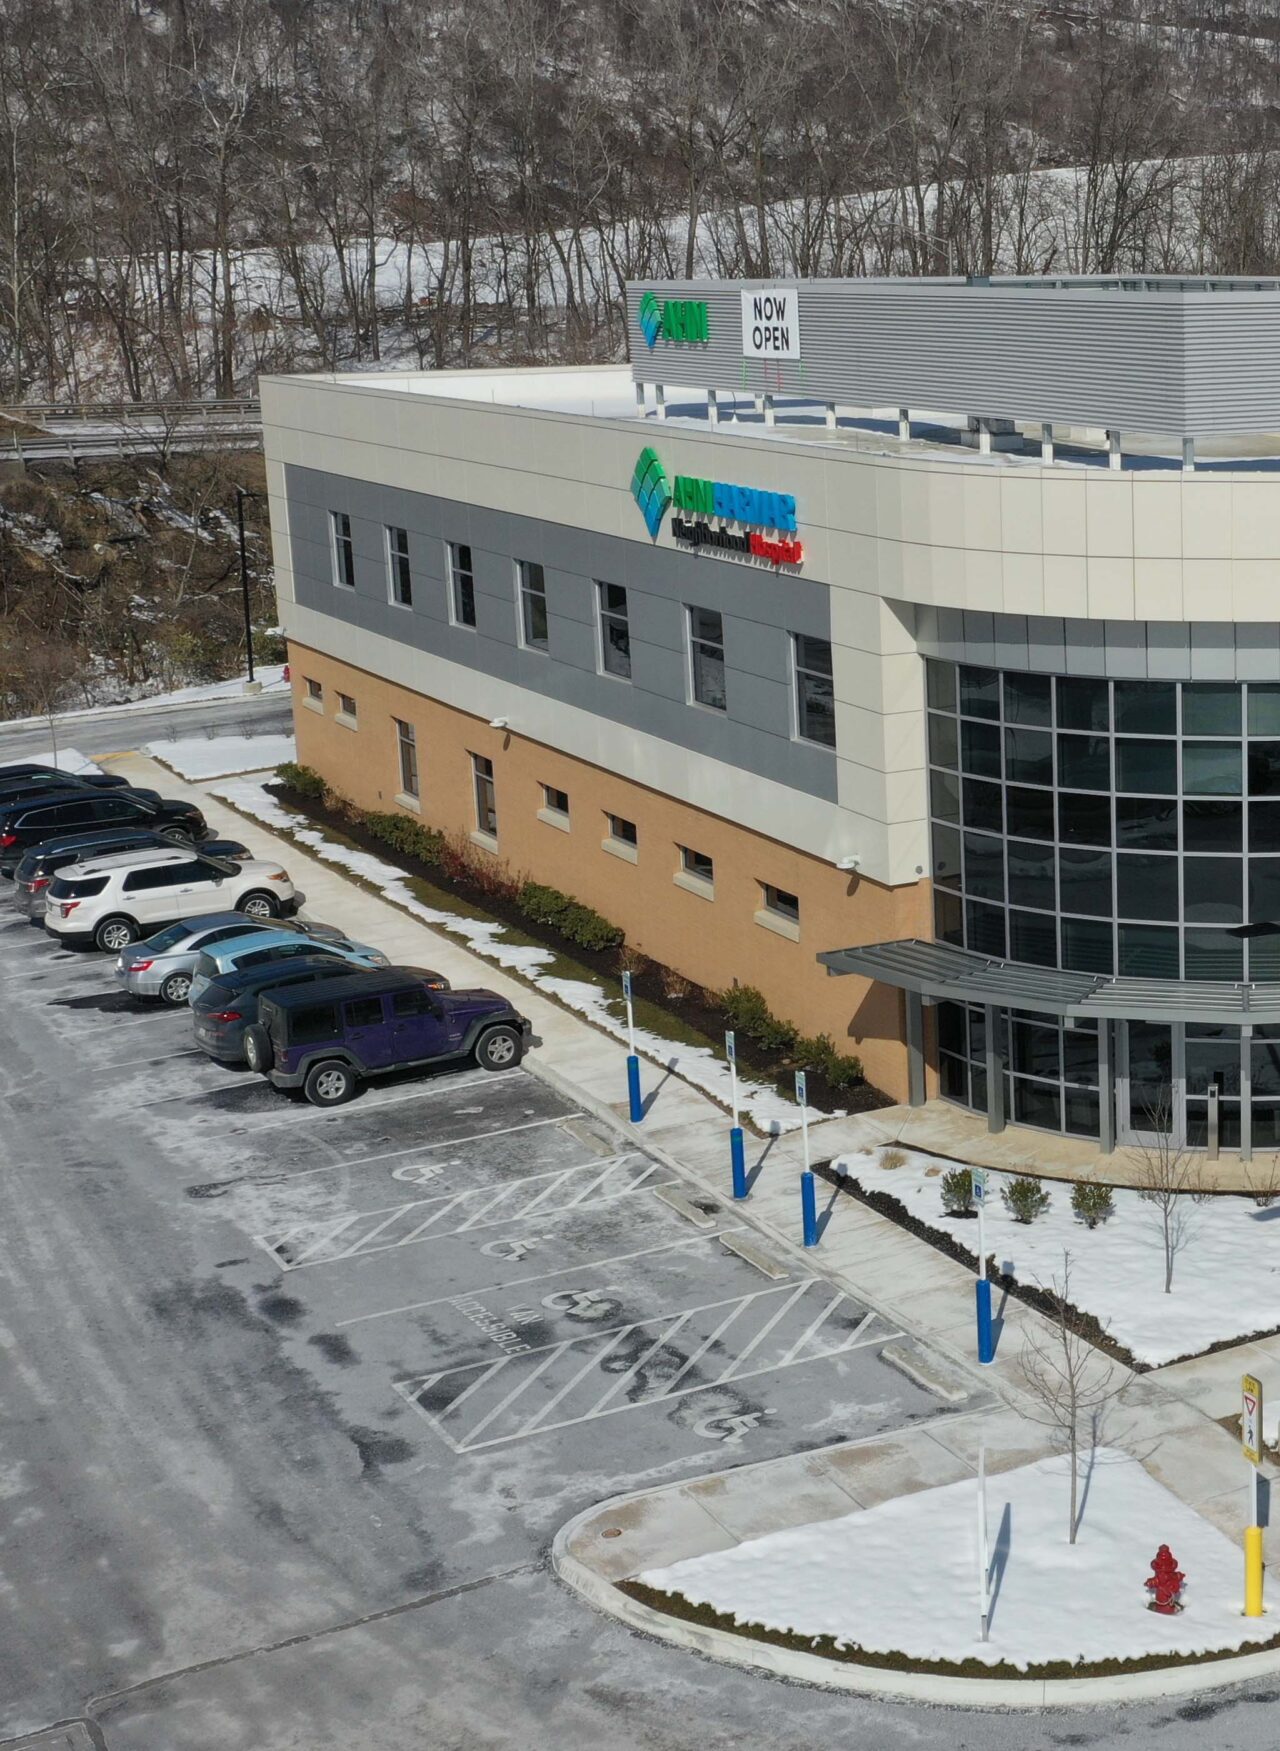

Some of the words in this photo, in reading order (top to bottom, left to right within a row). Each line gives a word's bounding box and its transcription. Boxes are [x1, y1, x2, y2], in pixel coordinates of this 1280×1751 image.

[662, 300, 709, 343] AHN
[753, 297, 786, 321] NOW
[752, 326, 790, 351] OPEN
[447, 1297, 532, 1354] ACCESSIBLE
